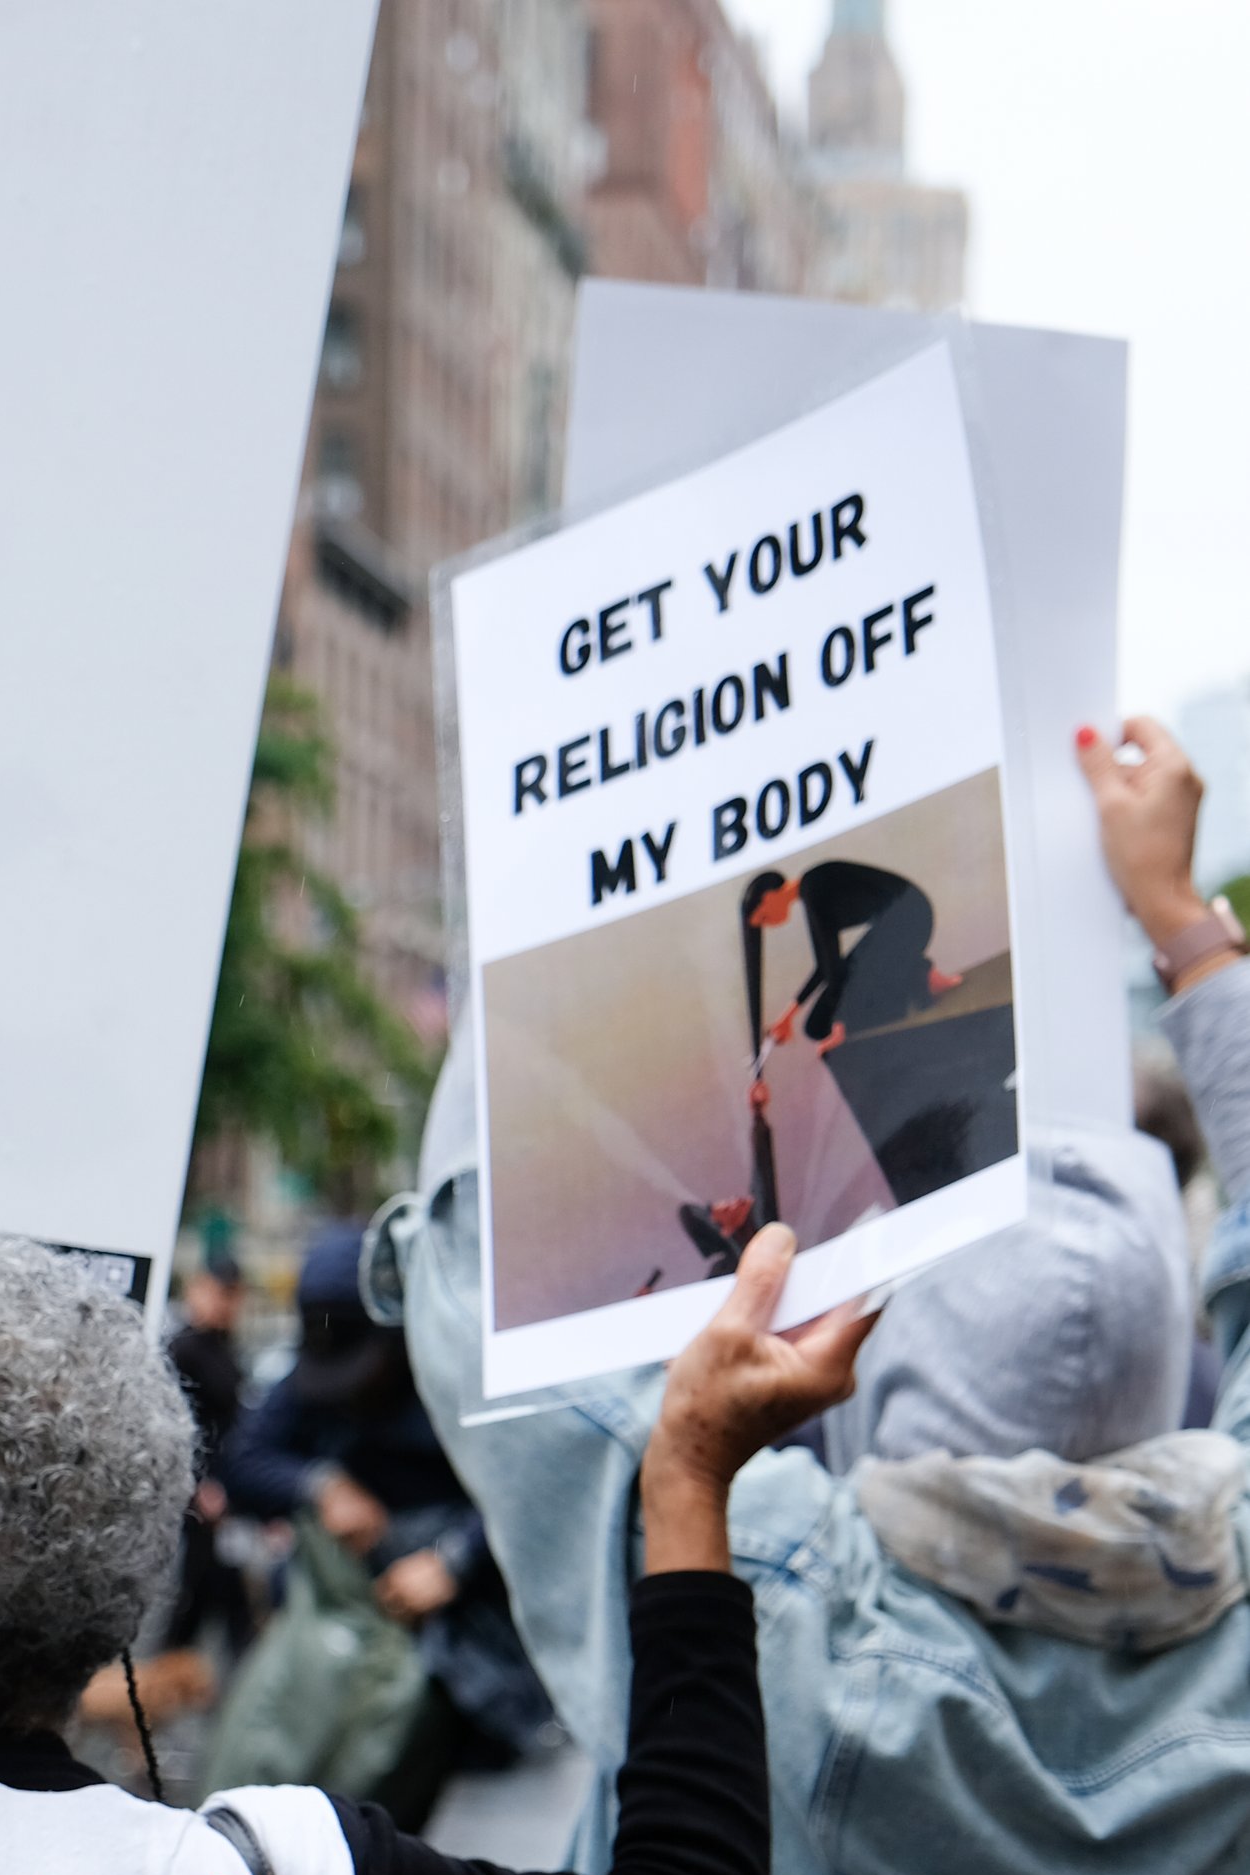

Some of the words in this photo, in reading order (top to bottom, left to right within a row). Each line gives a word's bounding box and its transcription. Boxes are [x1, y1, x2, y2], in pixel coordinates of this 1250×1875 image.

[558, 577, 672, 678] GET
[704, 491, 869, 614] YOUR
[511, 652, 793, 816] RELIGION
[820, 585, 938, 691] OFF
[588, 823, 677, 906] MY
[712, 738, 877, 862] BODY
